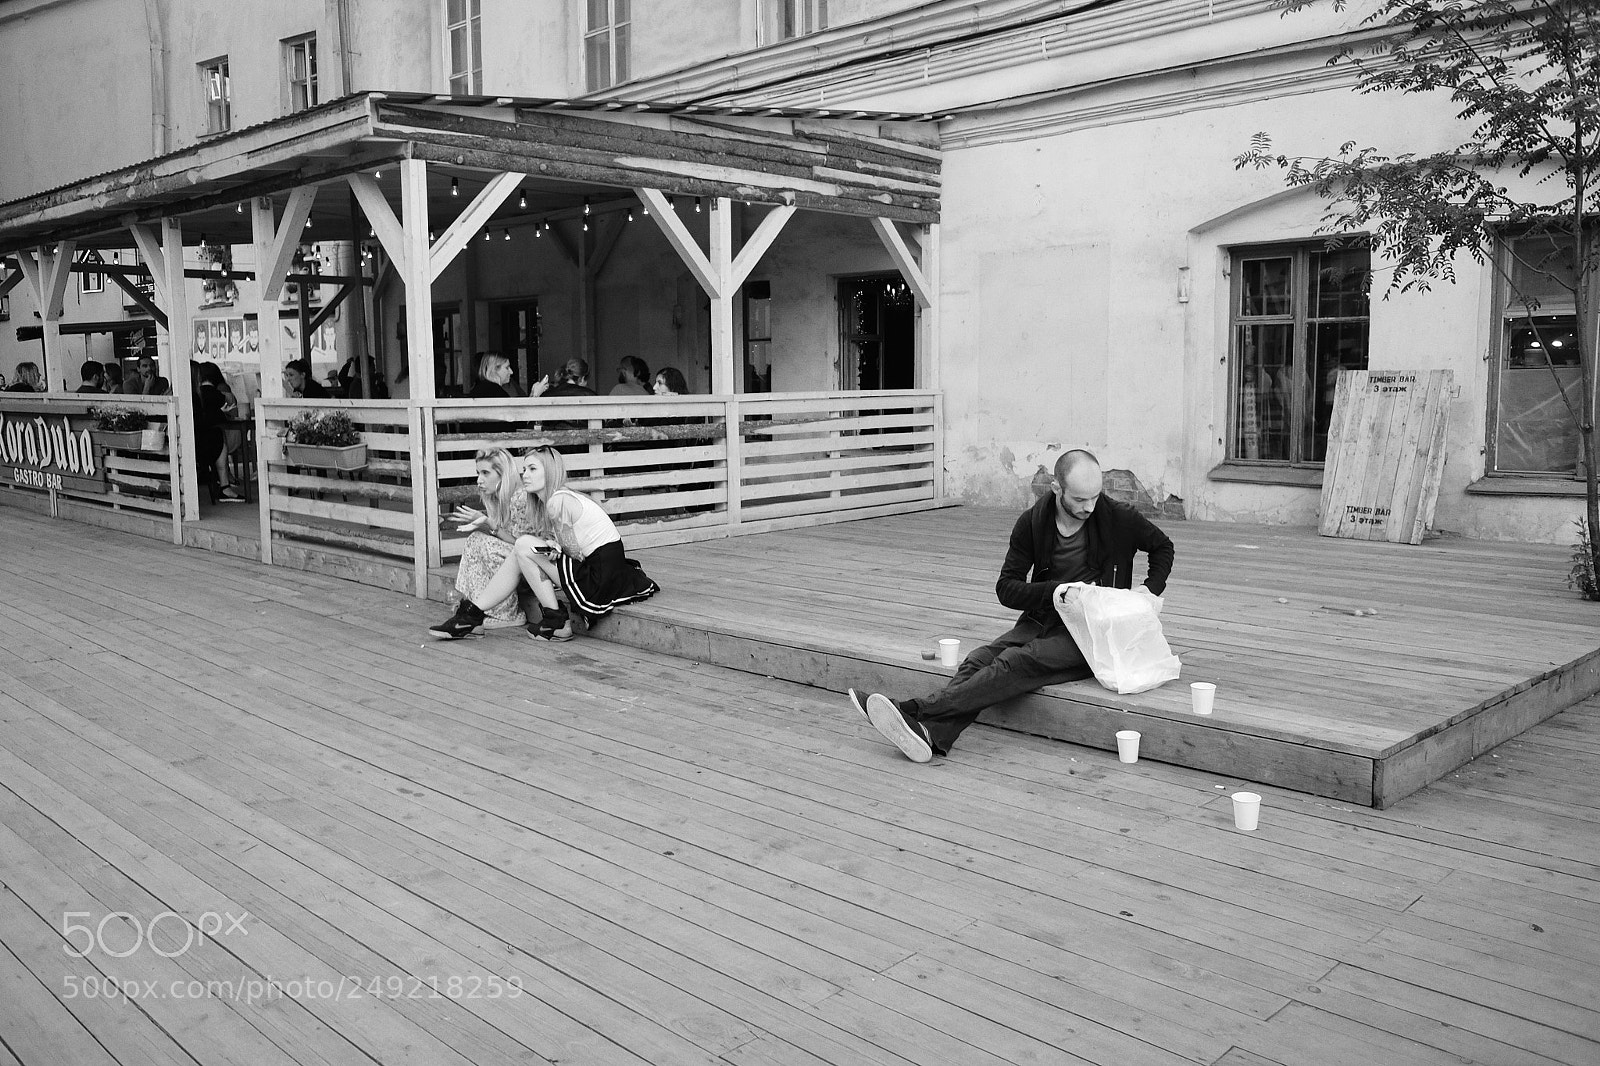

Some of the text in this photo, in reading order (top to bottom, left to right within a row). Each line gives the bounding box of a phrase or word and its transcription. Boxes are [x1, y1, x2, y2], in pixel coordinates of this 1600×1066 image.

[13, 467, 63, 490] GASTRO BAR
[1346, 505, 1391, 516] TIMBER BAR
[1350, 515, 1384, 525] 3 этаж
